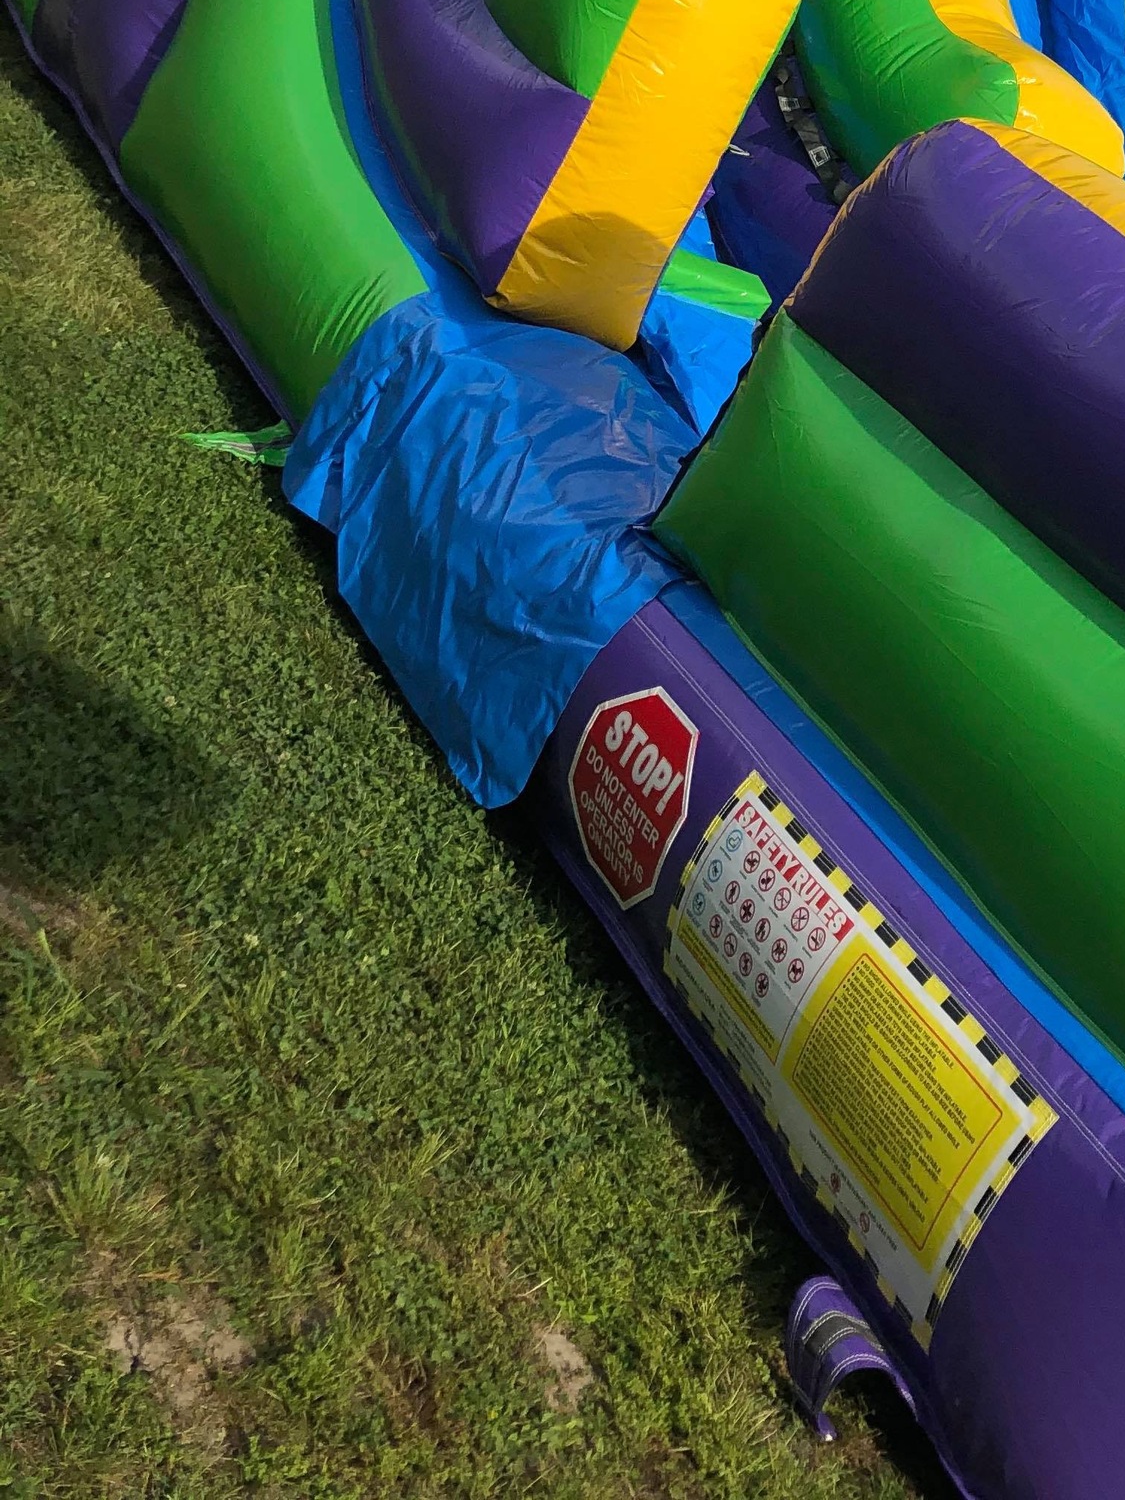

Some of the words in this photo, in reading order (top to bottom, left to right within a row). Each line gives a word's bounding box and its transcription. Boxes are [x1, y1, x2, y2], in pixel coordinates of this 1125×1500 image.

[585, 744, 604, 772] DO
[601, 765, 626, 801] NOT
[622, 793, 659, 849] ENTER
[604, 711, 684, 816] STOP!
[580, 792, 636, 868] OPERATOR
[632, 862, 644, 882] IS
[588, 824, 603, 850] ON
[603, 844, 630, 885] DUTY
[593, 782, 635, 844] UNLESS
[737, 804, 799, 876] SAFETY
[789, 865, 846, 934] RULES
